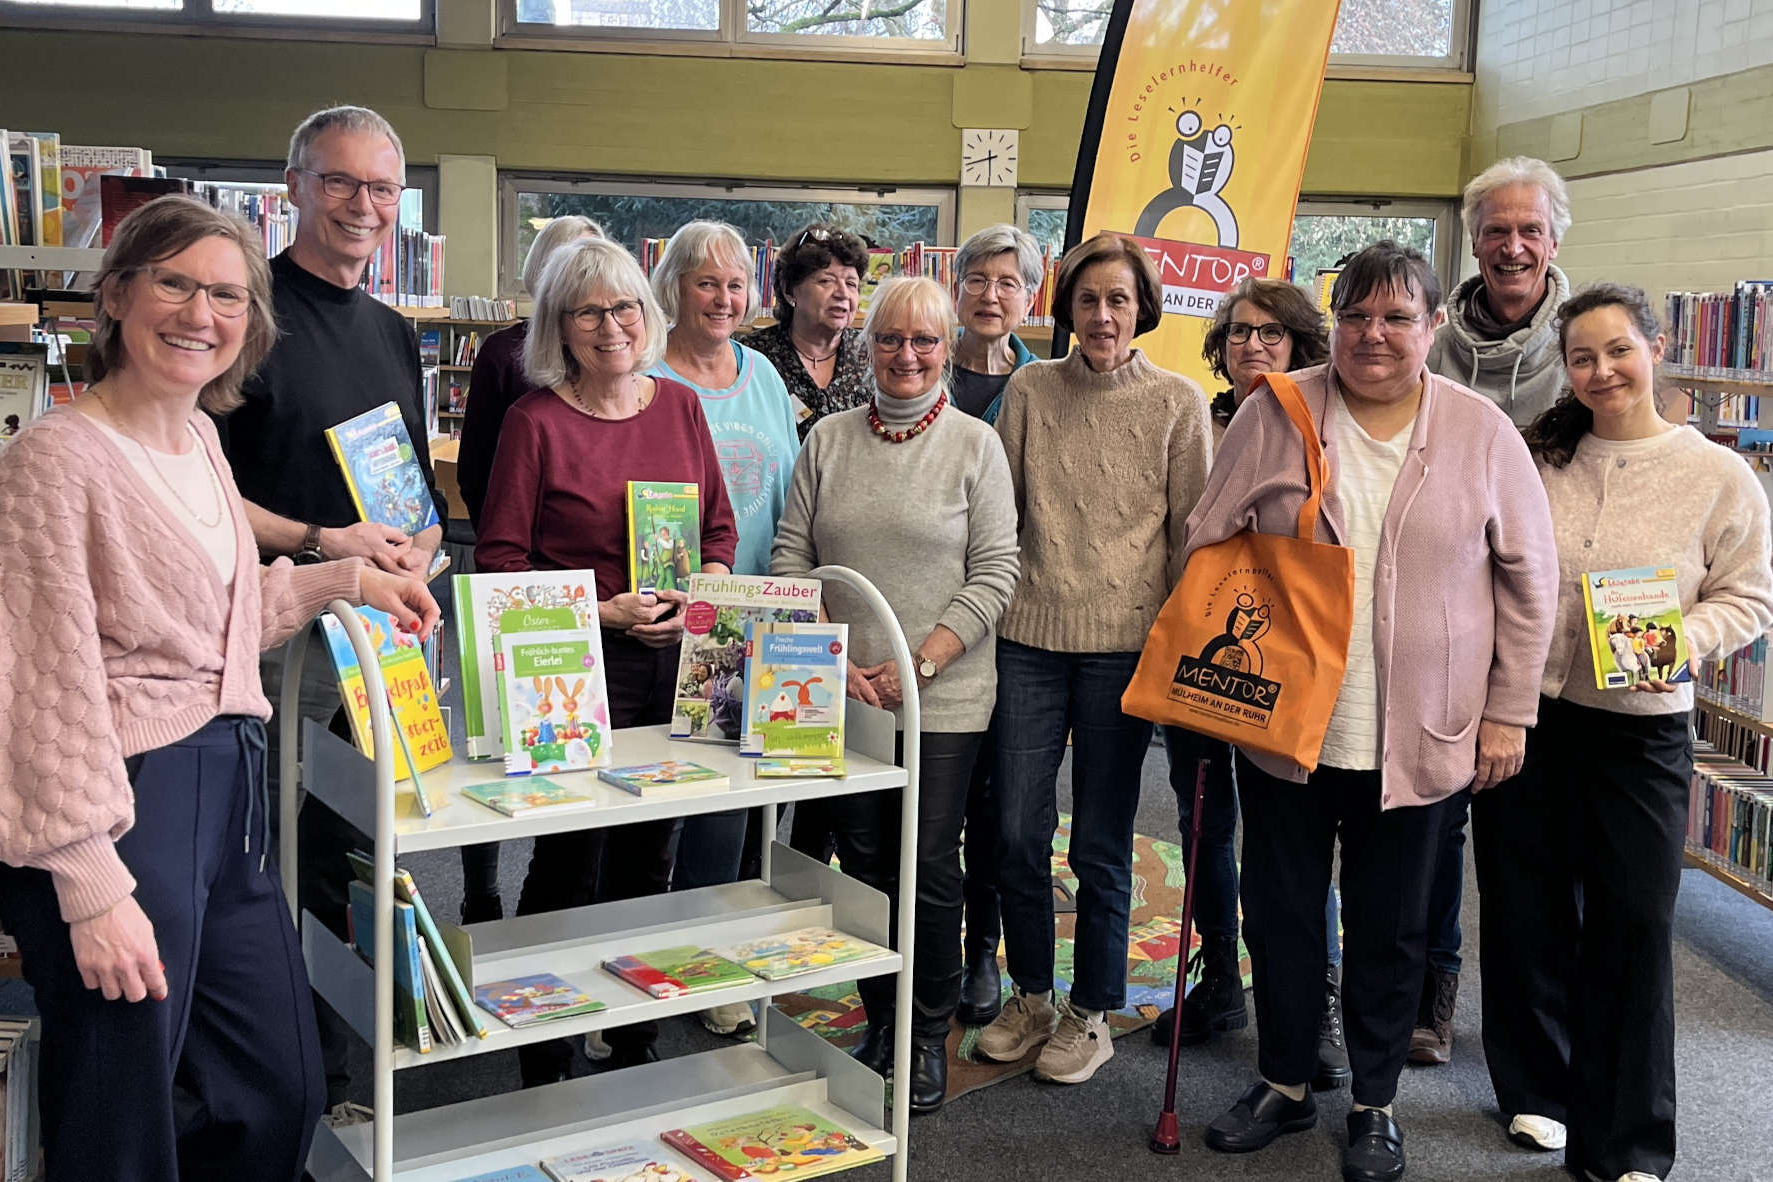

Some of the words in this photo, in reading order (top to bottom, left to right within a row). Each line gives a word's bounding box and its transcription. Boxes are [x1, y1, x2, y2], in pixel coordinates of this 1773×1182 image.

[1128, 60, 1238, 122] Leselernhelfer
[1127, 133, 1141, 163] Die
[1164, 293, 1183, 306] AN
[1187, 295, 1214, 310] DER
[1171, 686, 1209, 705] MÜLHEIM
[1209, 700, 1223, 709] AN
[1224, 704, 1241, 715] DER
[1243, 708, 1267, 723] RUHR
[406, 718, 440, 738] ster-
[420, 733, 447, 756] zeit
